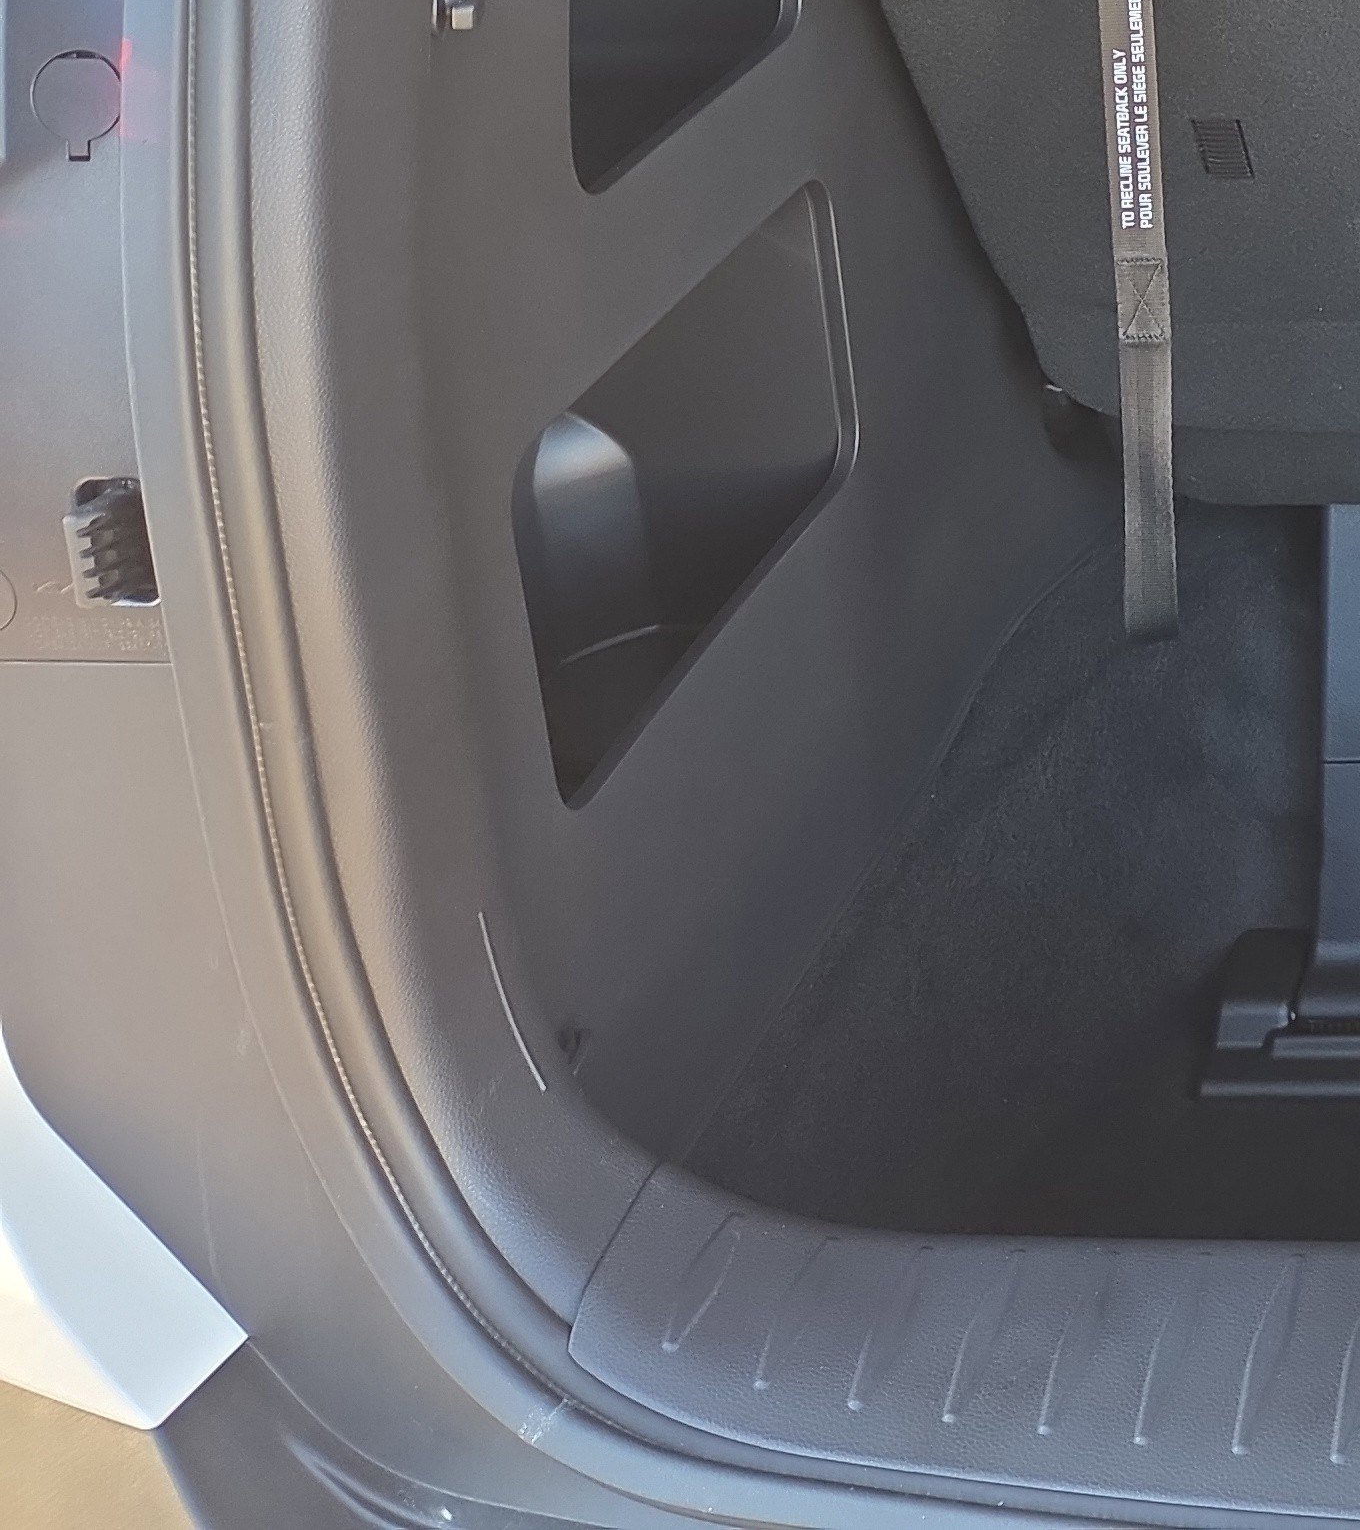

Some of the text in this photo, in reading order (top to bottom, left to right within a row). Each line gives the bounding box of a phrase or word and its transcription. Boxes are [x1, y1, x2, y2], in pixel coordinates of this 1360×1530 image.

[1112, 48, 1135, 229] TO RECLINE SEATBACK ONLY
[1134, 106, 1148, 123] LE
[1135, 124, 1152, 191] SOULEVER
[1139, 194, 1154, 230] POUR
